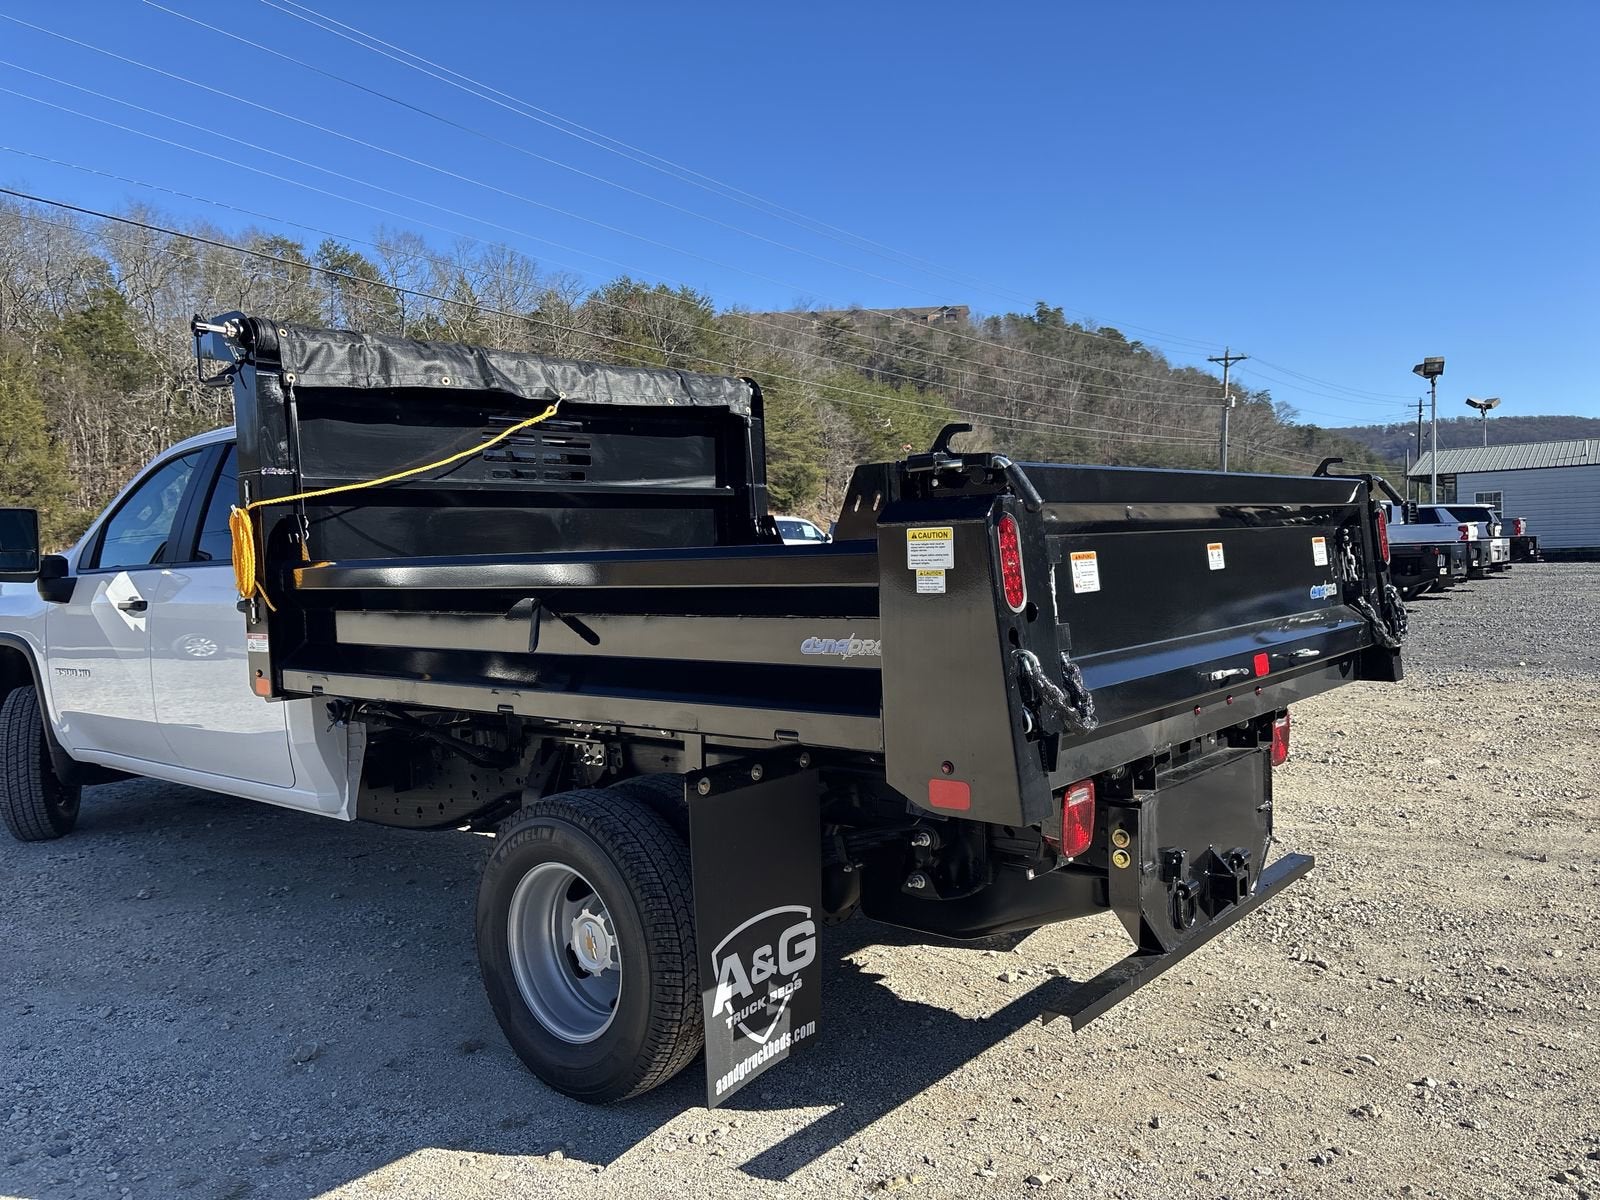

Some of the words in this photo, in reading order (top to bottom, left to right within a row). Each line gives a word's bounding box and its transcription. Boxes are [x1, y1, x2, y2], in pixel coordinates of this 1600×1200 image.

[917, 531, 948, 539] CAUTION
[499, 828, 551, 862] MICHELIN
[712, 919, 816, 1018] A&G
[725, 995, 767, 1030] TRUCK
[715, 1020, 816, 1096] aandgtruckbeds.com
